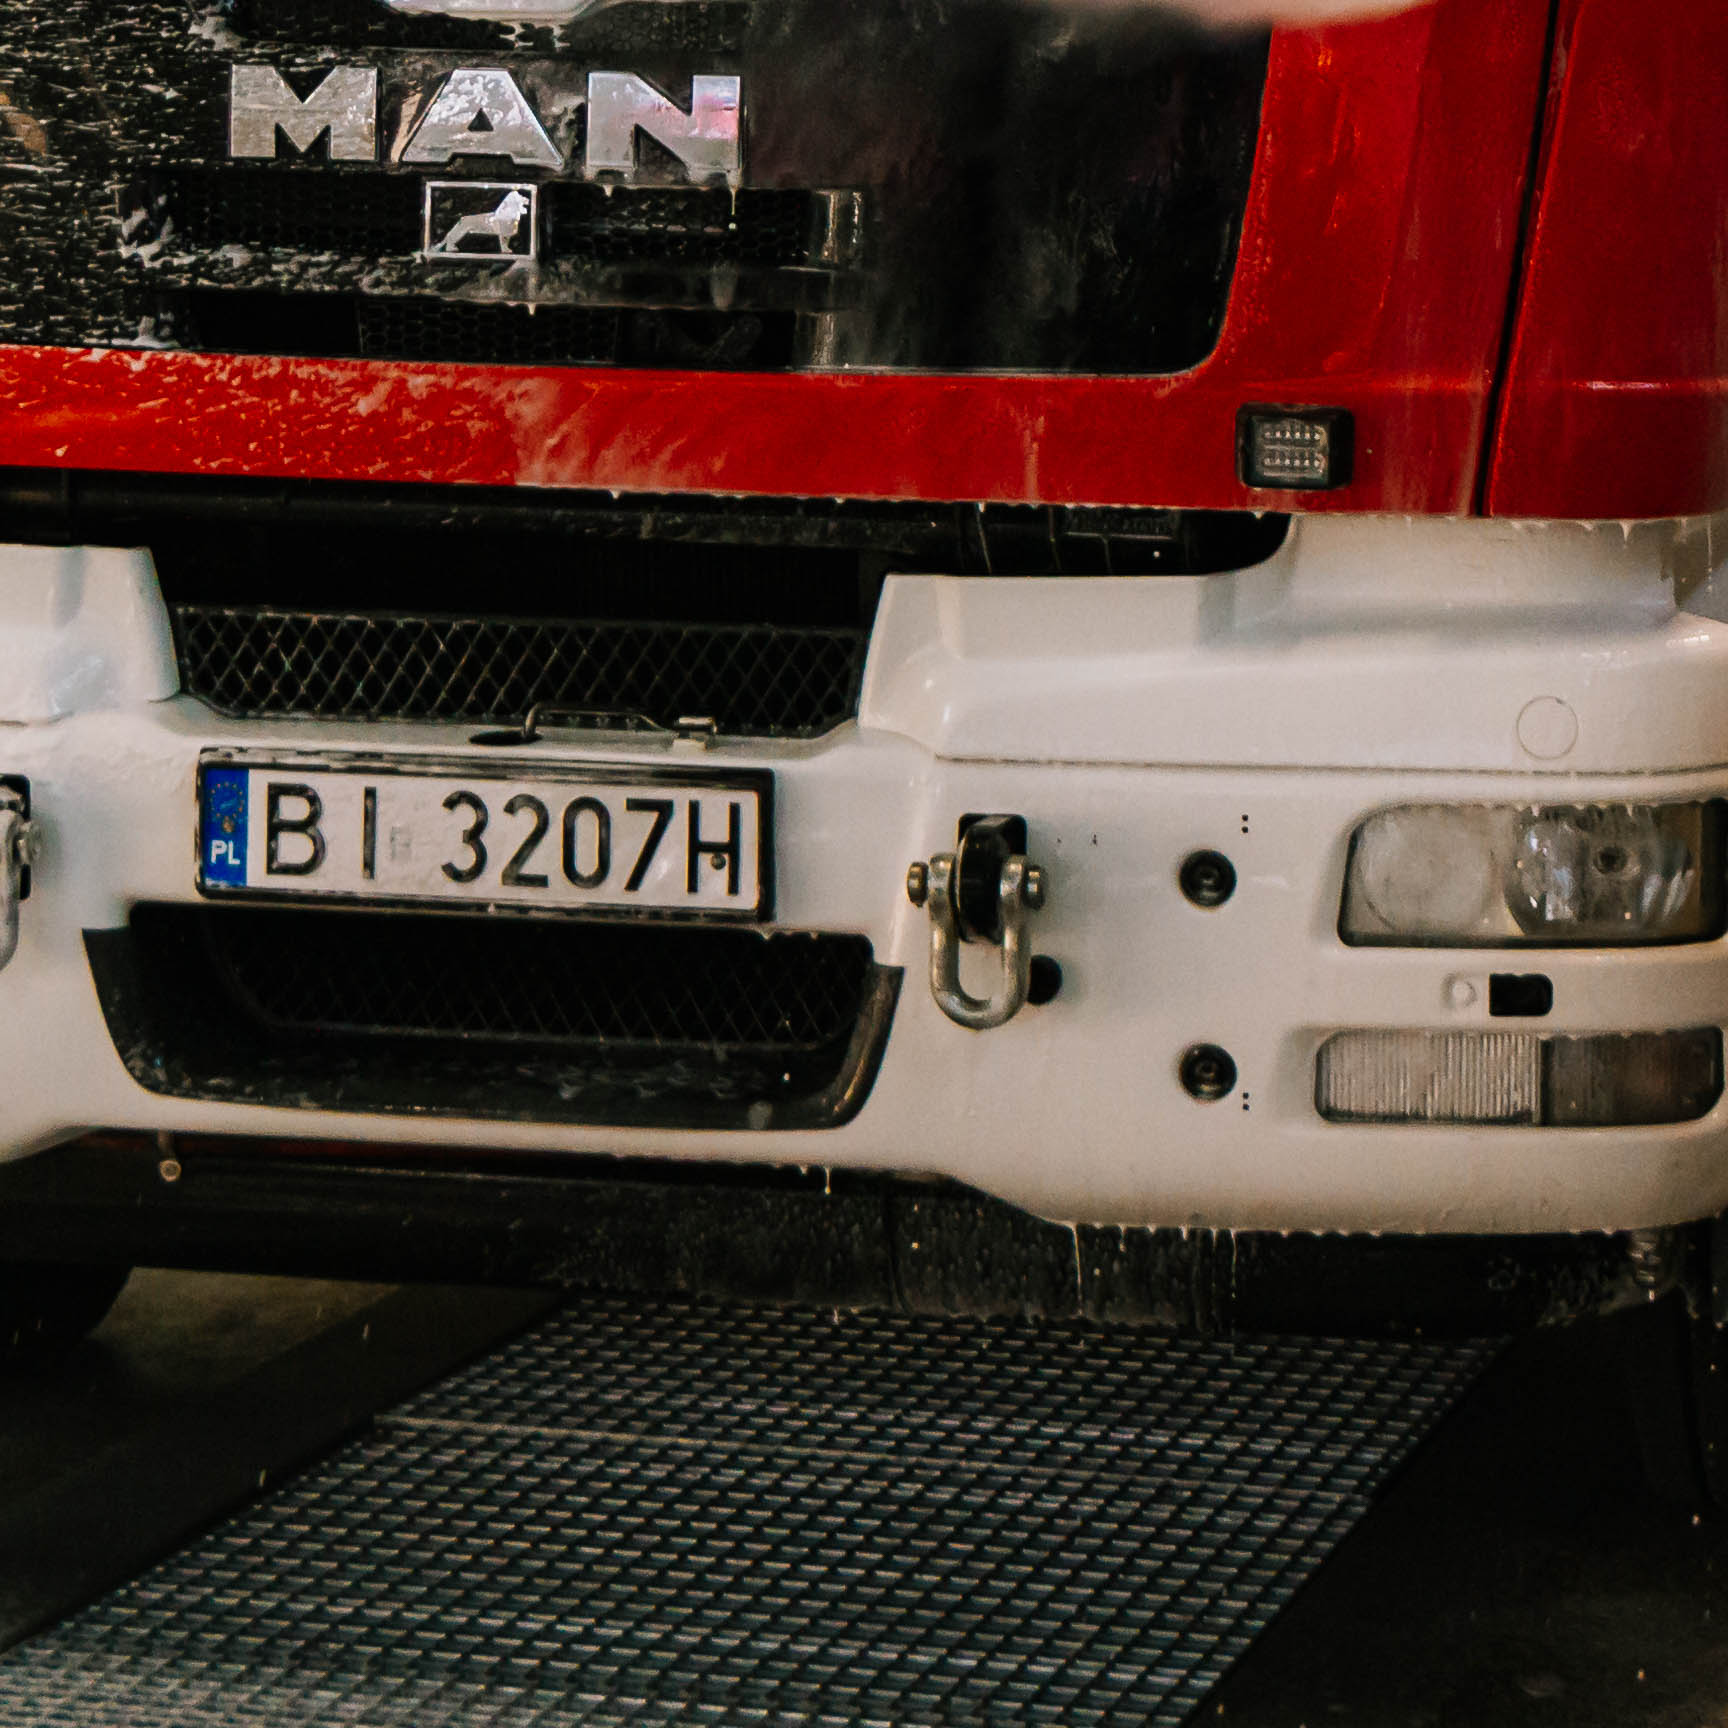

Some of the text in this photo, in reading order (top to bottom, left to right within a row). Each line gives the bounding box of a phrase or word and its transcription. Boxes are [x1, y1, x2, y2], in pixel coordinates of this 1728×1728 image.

[229, 64, 742, 172] MAN
[210, 839, 241, 865] PL
[266, 782, 741, 895] BI 3207H
